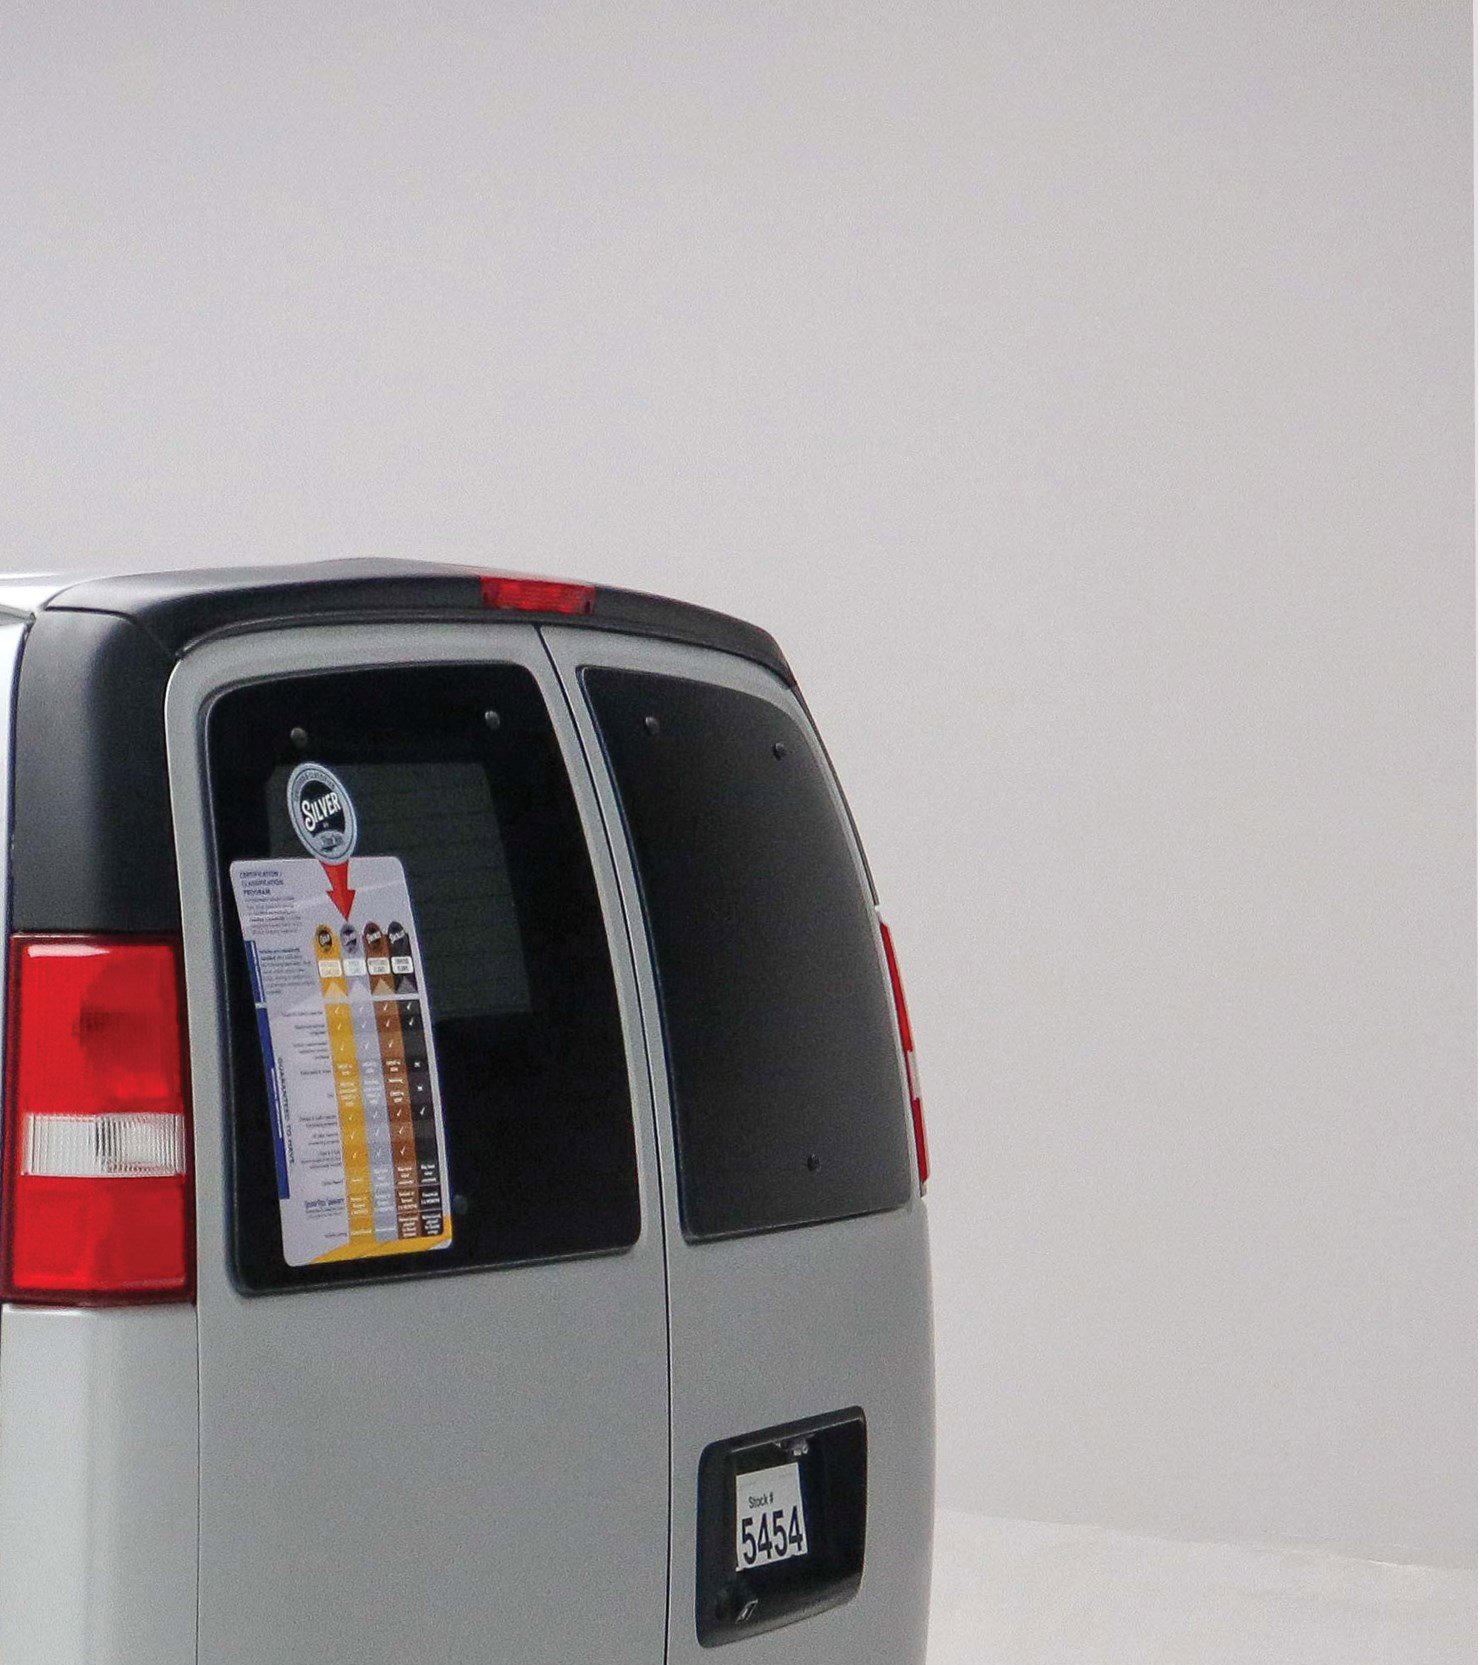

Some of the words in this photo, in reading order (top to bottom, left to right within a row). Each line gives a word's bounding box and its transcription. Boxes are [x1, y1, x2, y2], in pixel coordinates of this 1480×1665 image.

[302, 792, 341, 832] SILVER
[748, 1494, 768, 1509] Stock
[768, 1492, 775, 1504] #
[742, 1506, 803, 1565] 5454
